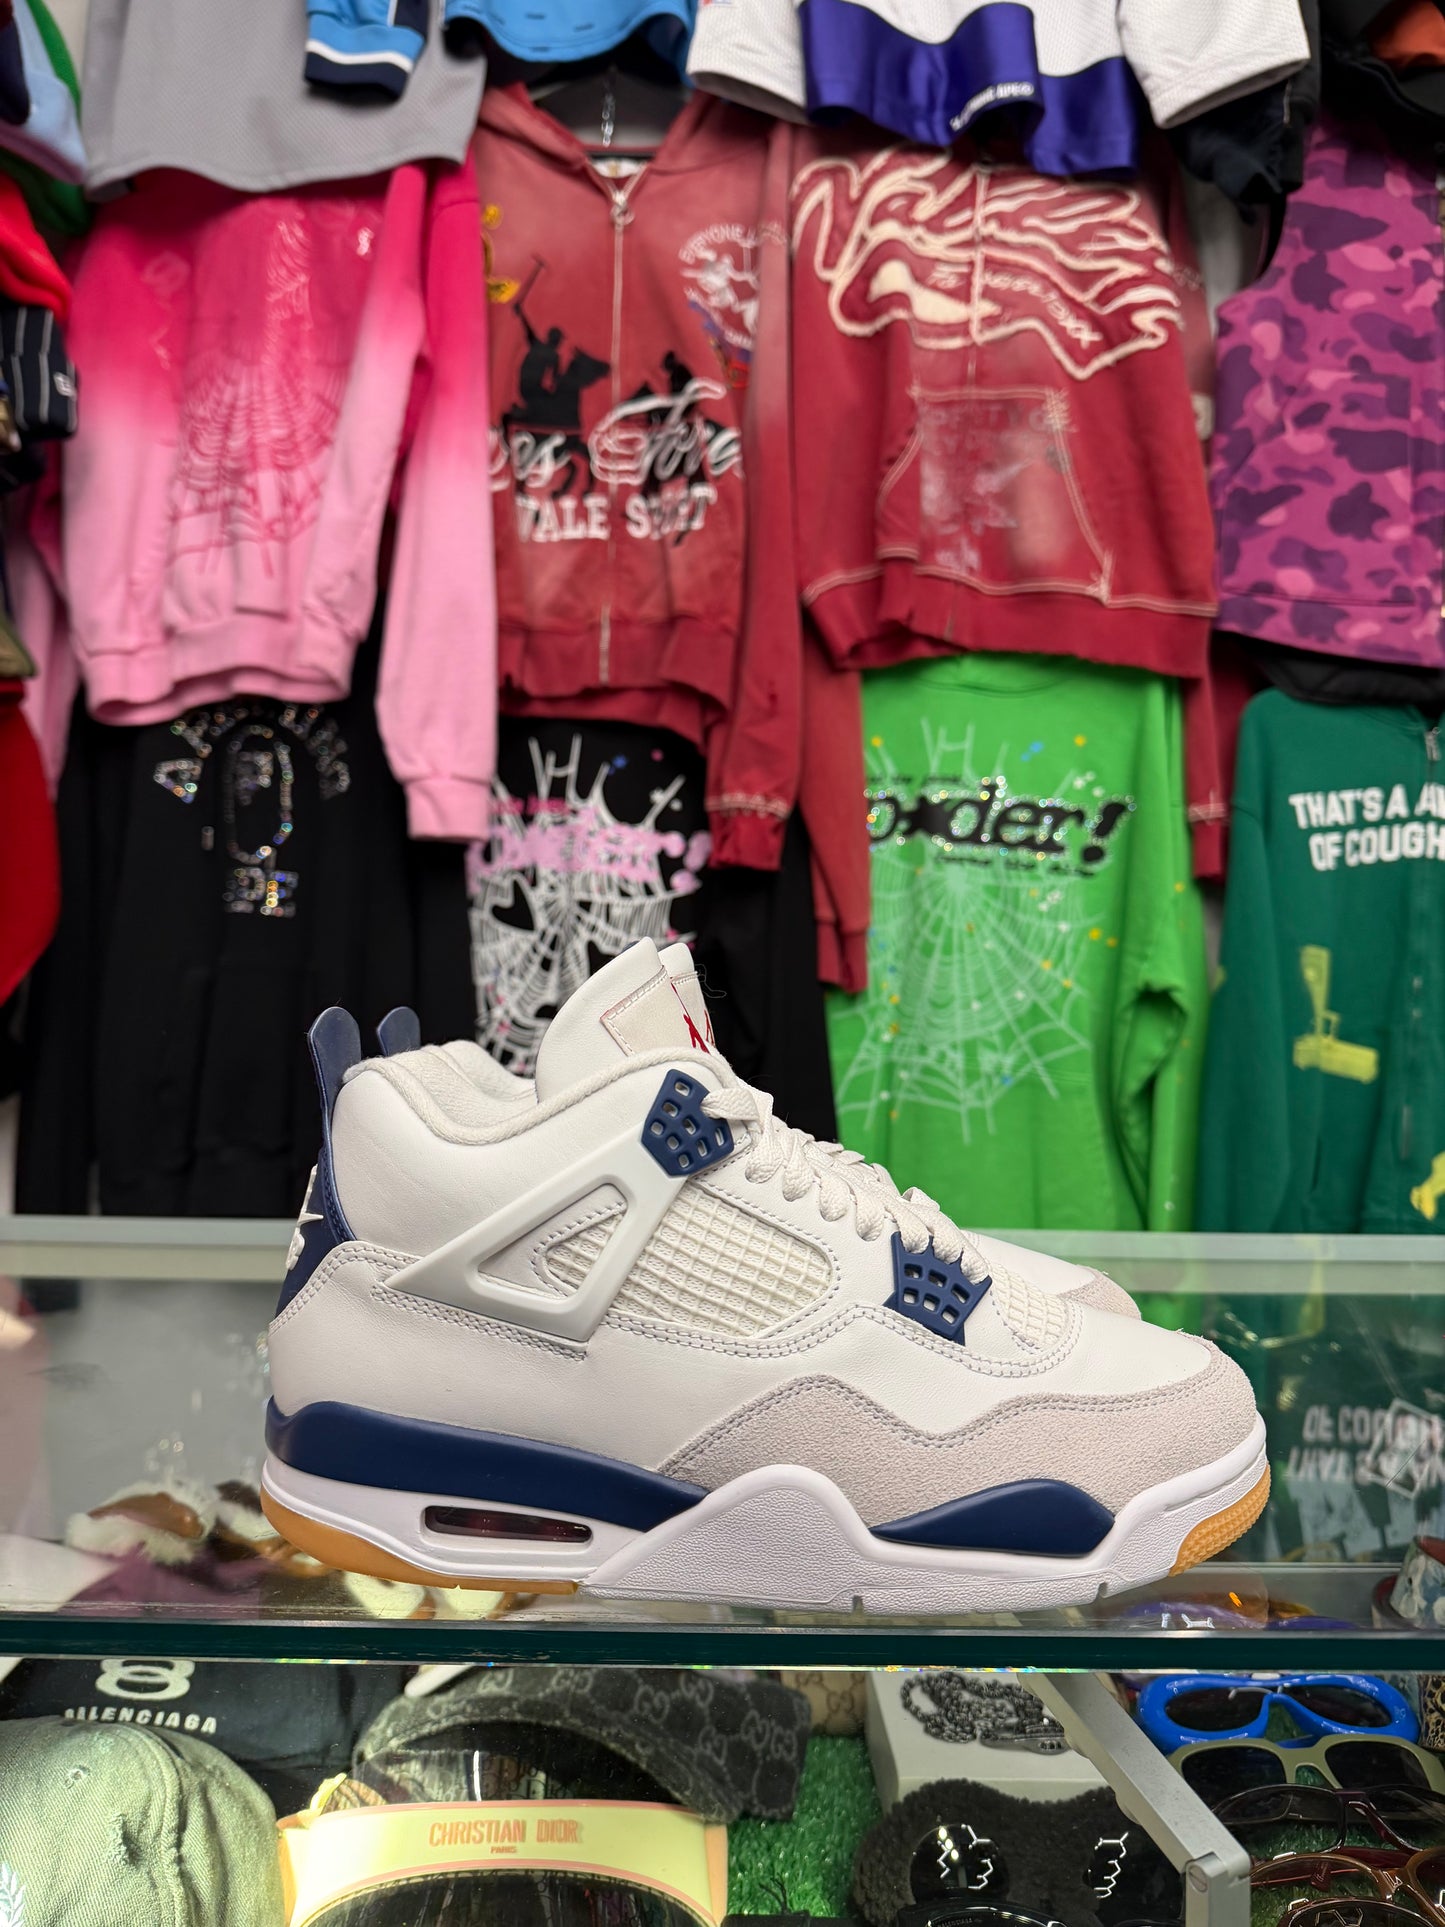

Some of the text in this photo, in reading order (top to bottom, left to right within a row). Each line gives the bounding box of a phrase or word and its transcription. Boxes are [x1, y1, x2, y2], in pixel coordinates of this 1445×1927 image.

[1288, 787, 1385, 829] THAT'S
[1385, 784, 1410, 820] A
[1309, 821, 1445, 871] OF COUGH
[429, 1819, 581, 1847] CHRISTIAN DIOR
[490, 1846, 518, 1854] PARIS
